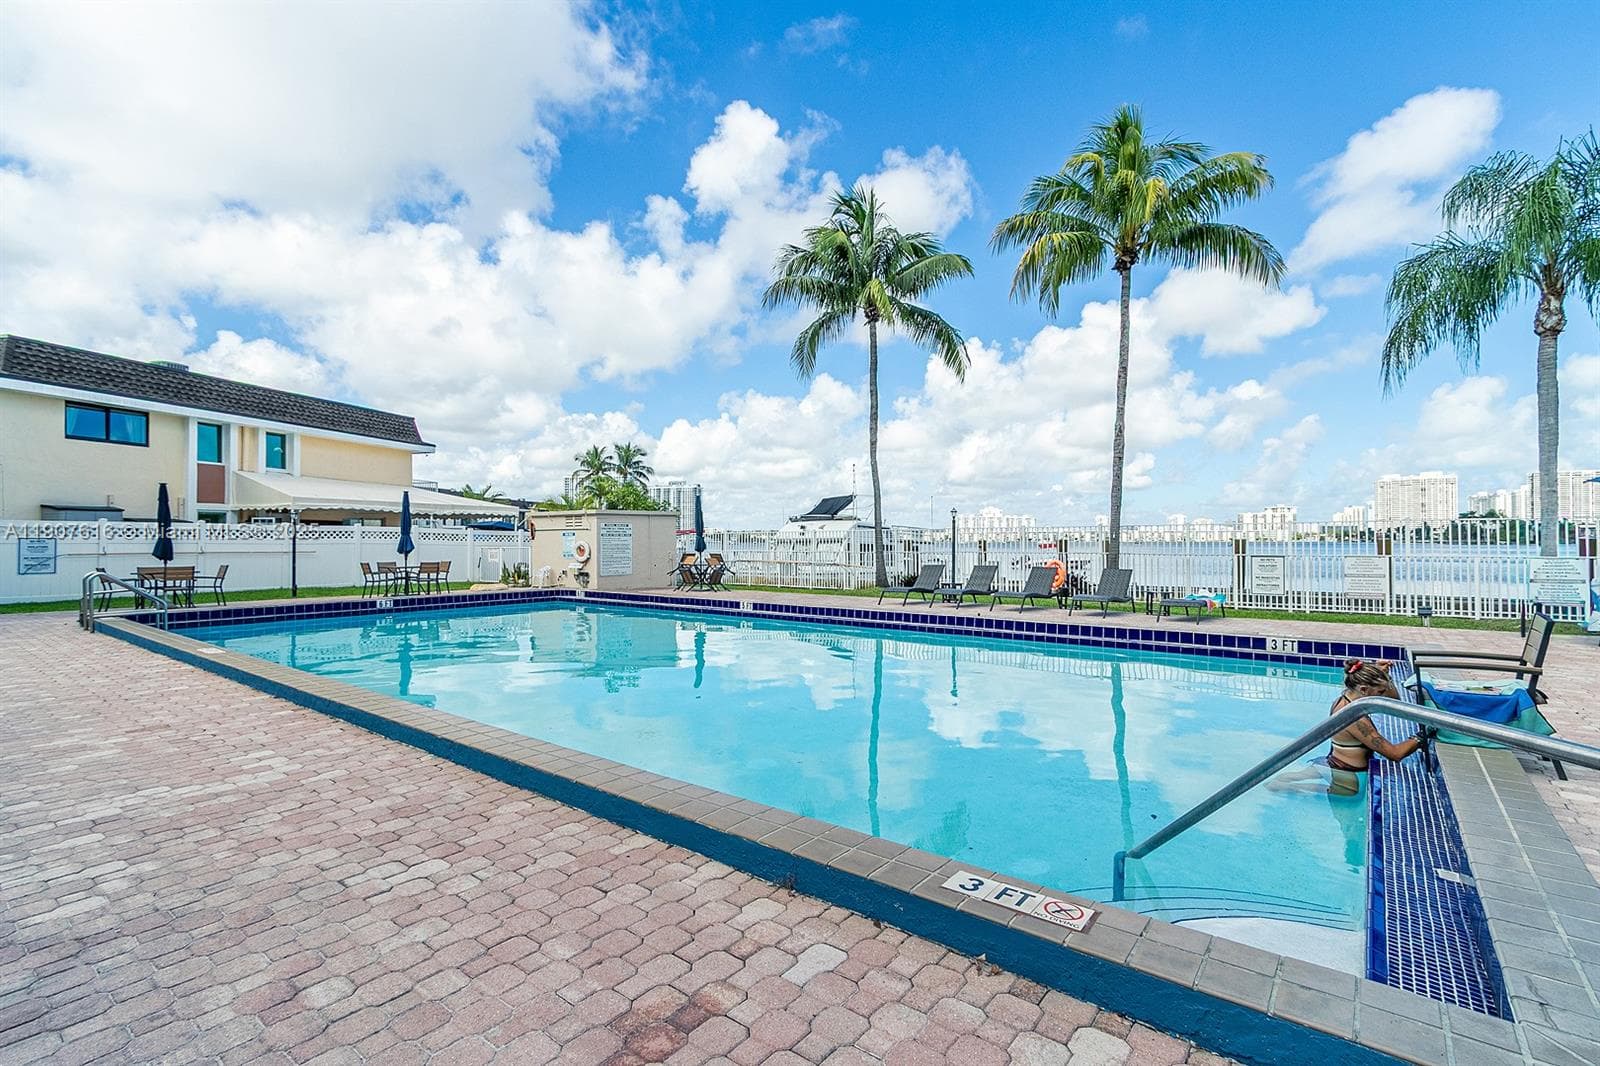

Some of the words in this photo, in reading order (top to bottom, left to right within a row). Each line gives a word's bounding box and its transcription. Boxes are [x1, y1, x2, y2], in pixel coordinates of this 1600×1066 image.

[1271, 639, 1278, 651] 3
[1282, 639, 1297, 652] FT
[958, 877, 985, 892] 3
[994, 886, 1036, 907] FT
[1033, 911, 1047, 919] NO
[1048, 916, 1080, 929] DIVING
